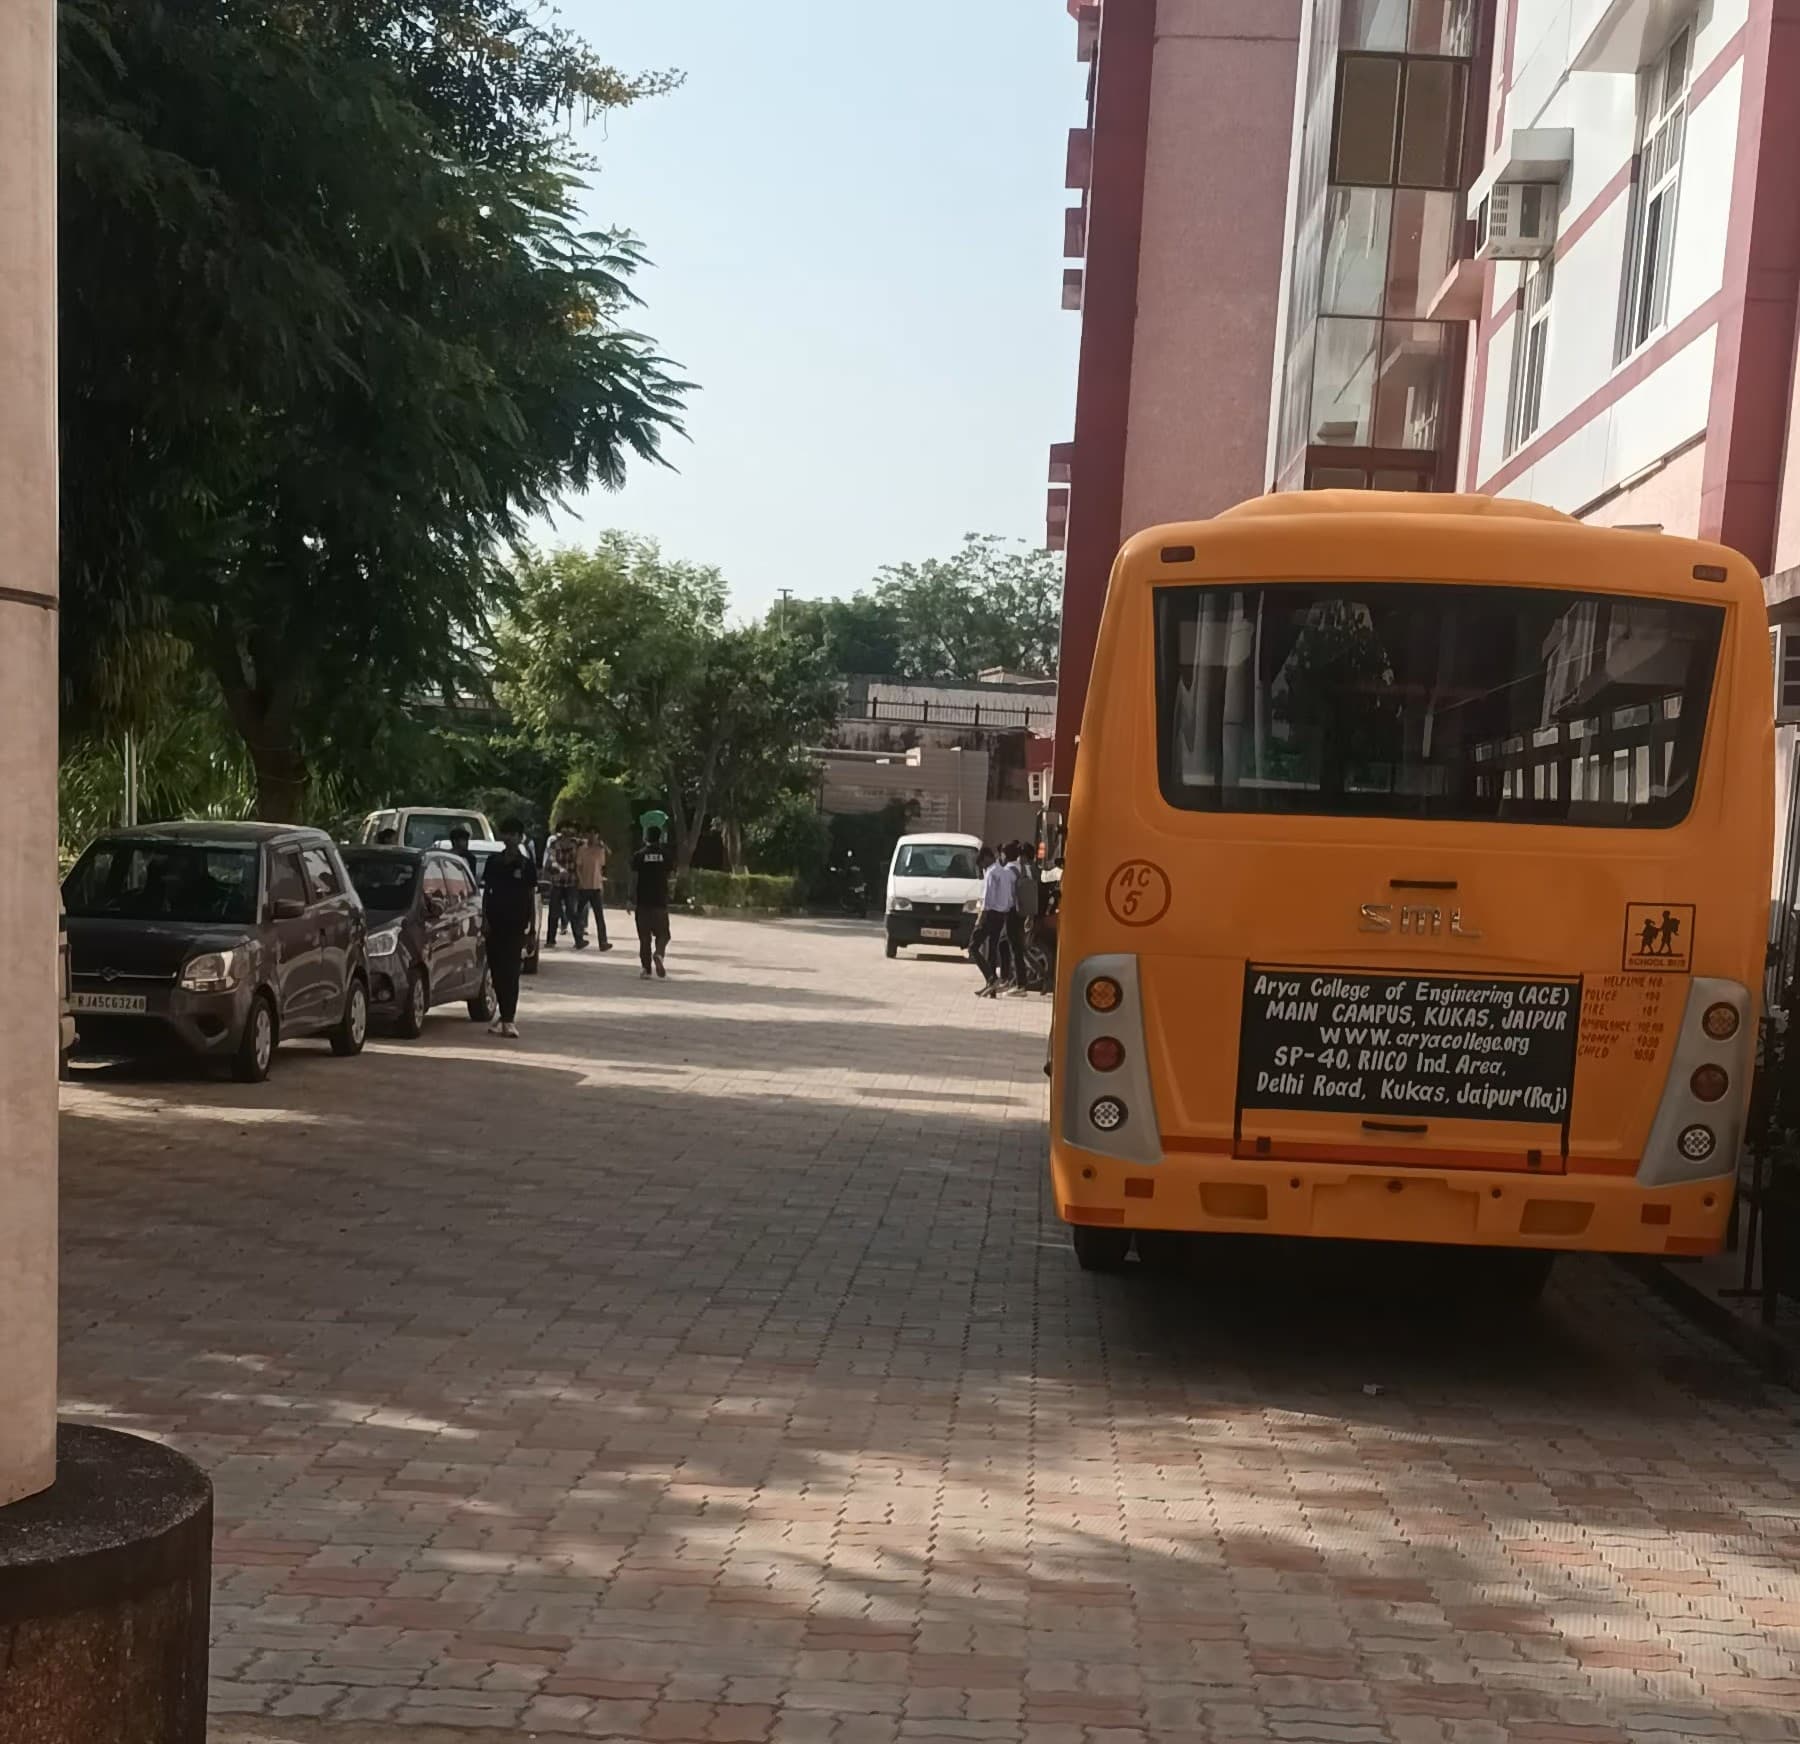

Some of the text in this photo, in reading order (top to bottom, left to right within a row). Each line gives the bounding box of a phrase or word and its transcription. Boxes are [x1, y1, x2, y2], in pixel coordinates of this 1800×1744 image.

[1120, 868, 1151, 887] AC
[1123, 890, 1143, 916] 5
[1254, 975, 1570, 1009] Arya College of Engineering (ACE)
[1585, 989, 1617, 1001] POLICE
[1265, 1000, 1567, 1031] MAIN CAMPUS, KUKAS, JAIPUR
[1583, 1003, 1605, 1016] FIRE
[1274, 1046, 1507, 1077] SP-40, RIICO Ind. Area,
[1578, 1045, 1610, 1058] CHILD
[1256, 1071, 1305, 1095] Delhi
[1313, 1074, 1367, 1100] Road,
[1380, 1078, 1450, 1104] Kukas,
